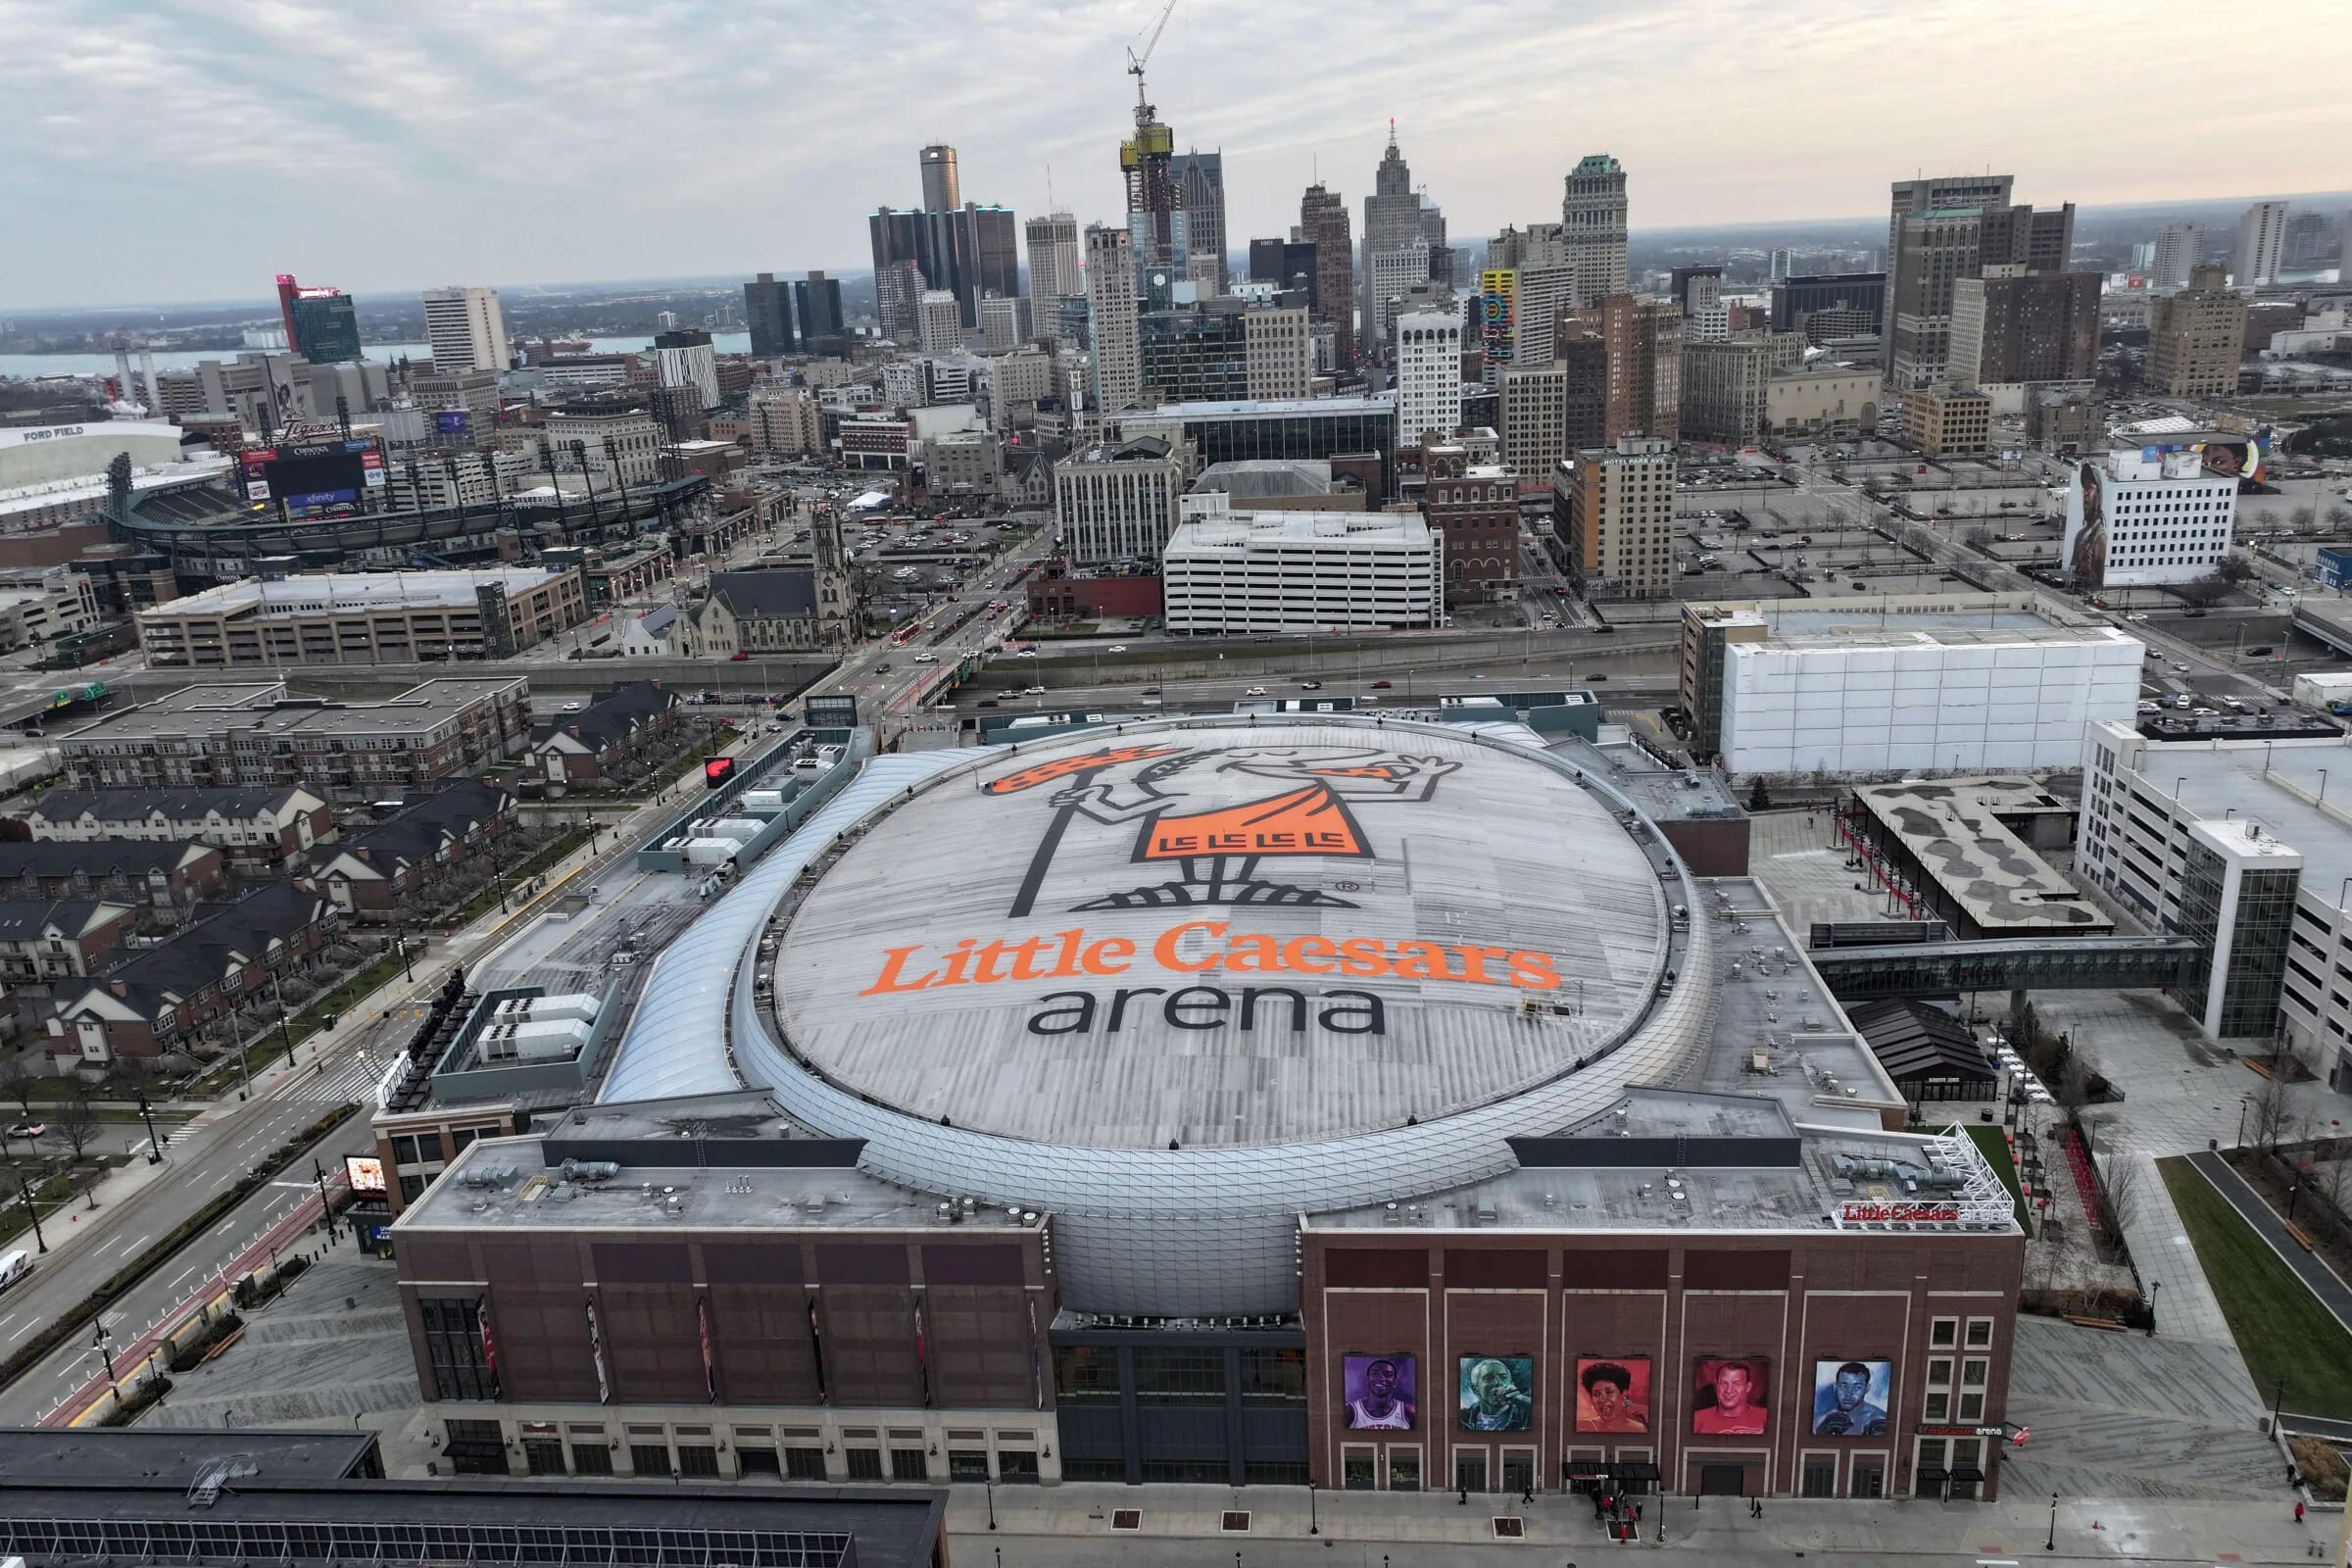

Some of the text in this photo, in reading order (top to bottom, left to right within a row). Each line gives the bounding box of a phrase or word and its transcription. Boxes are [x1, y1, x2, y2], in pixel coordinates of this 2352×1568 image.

[24, 426, 83, 442] FORD FIELD
[282, 418, 337, 443] Tigers
[306, 493, 335, 504] xfinity
[858, 920, 1562, 997] Little Caesars
[1027, 986, 1386, 1036] arena
[1843, 1204, 2011, 1222] Little Caesars arena
[1976, 1427, 2002, 1436] arena
